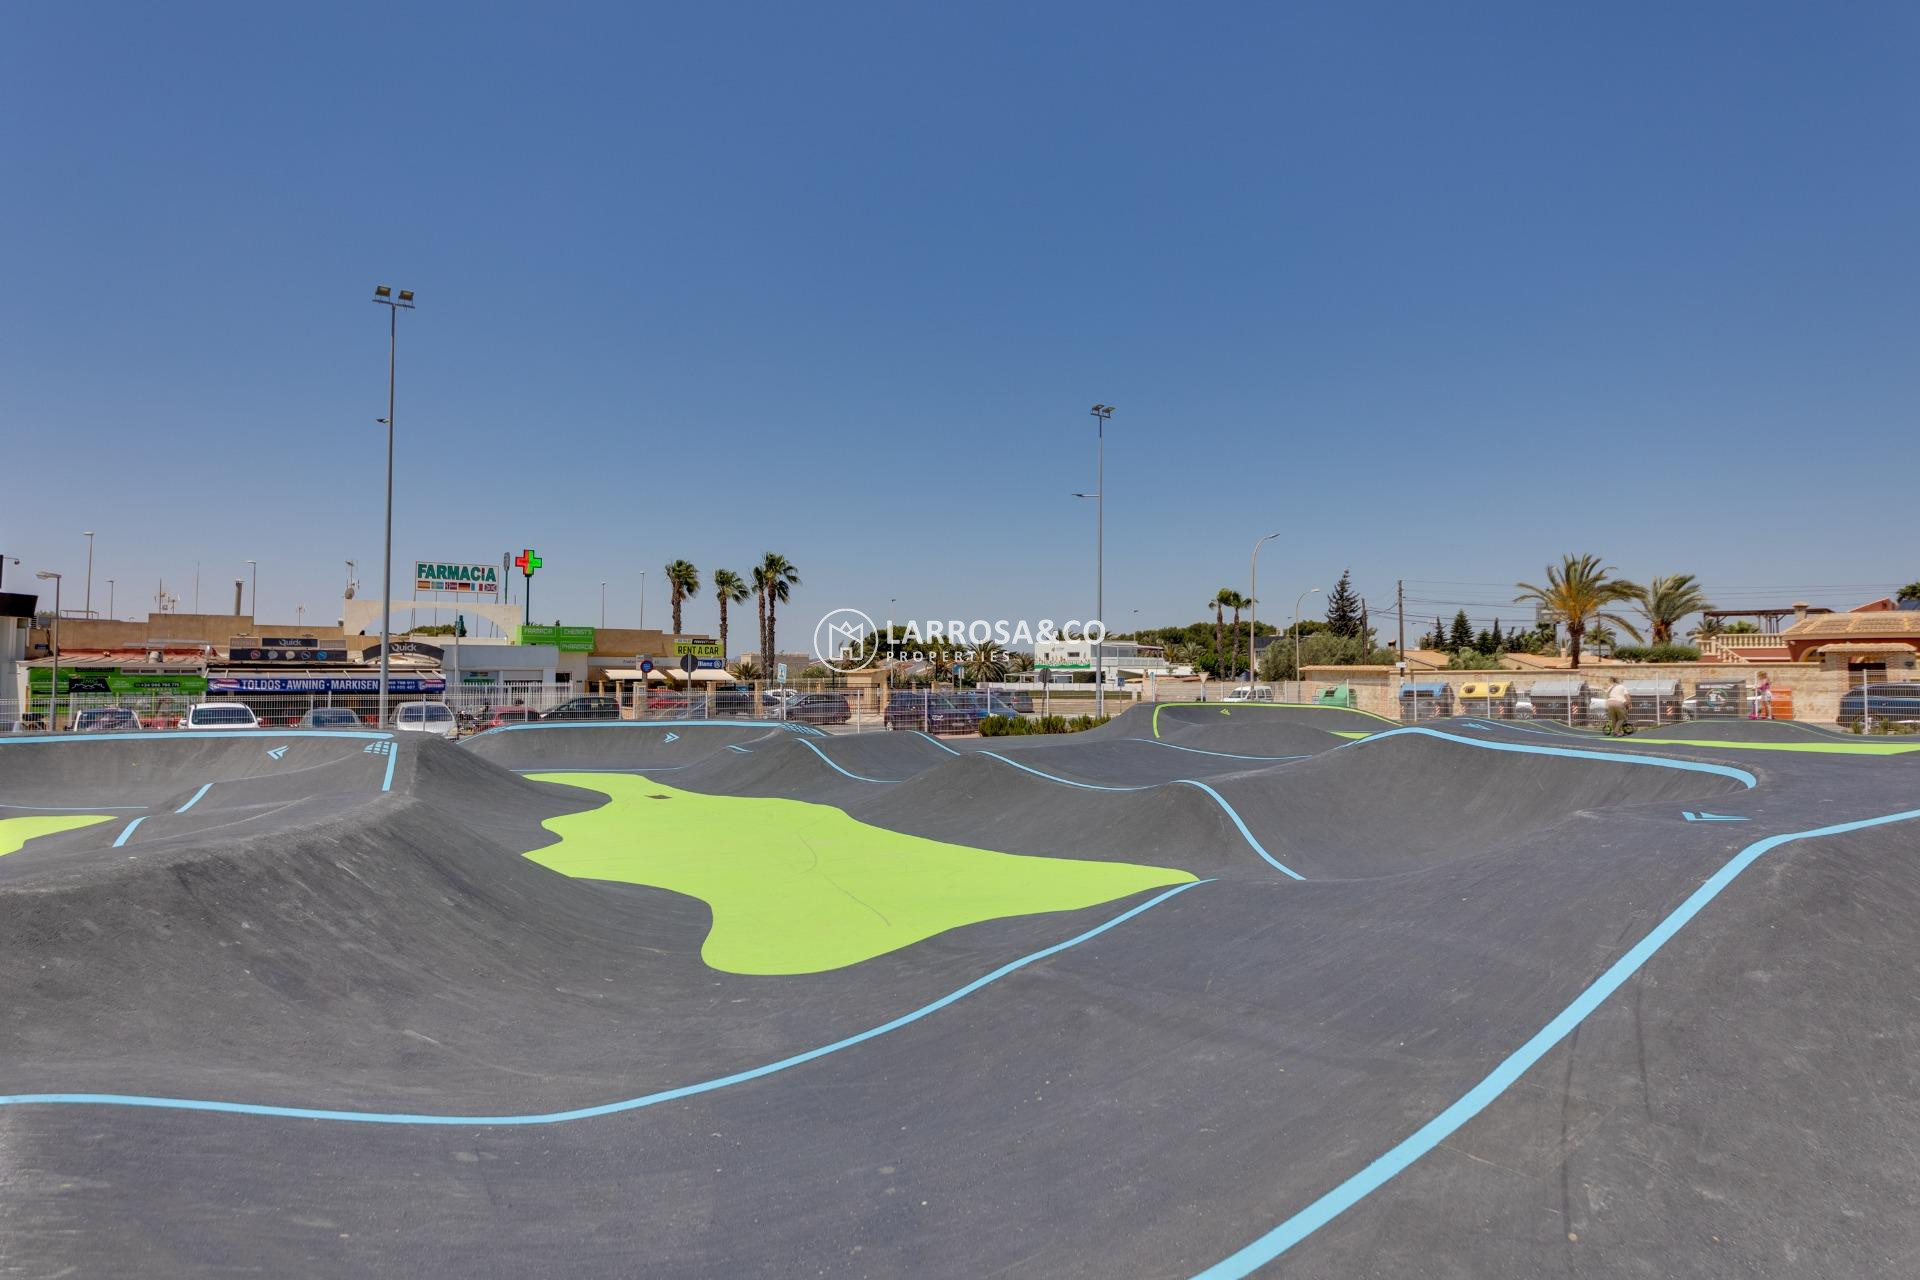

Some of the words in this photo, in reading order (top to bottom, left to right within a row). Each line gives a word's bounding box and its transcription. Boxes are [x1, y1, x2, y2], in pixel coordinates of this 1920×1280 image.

[417, 563, 496, 582] FARMACIA
[279, 638, 302, 647] Quick
[391, 643, 417, 652] Quick
[677, 645, 696, 655] RENT
[698, 645, 703, 655] A
[704, 645, 719, 655] CAR
[241, 679, 281, 690] TOLDOS
[286, 679, 325, 690] AWNING
[331, 680, 379, 690] MARKISEN
